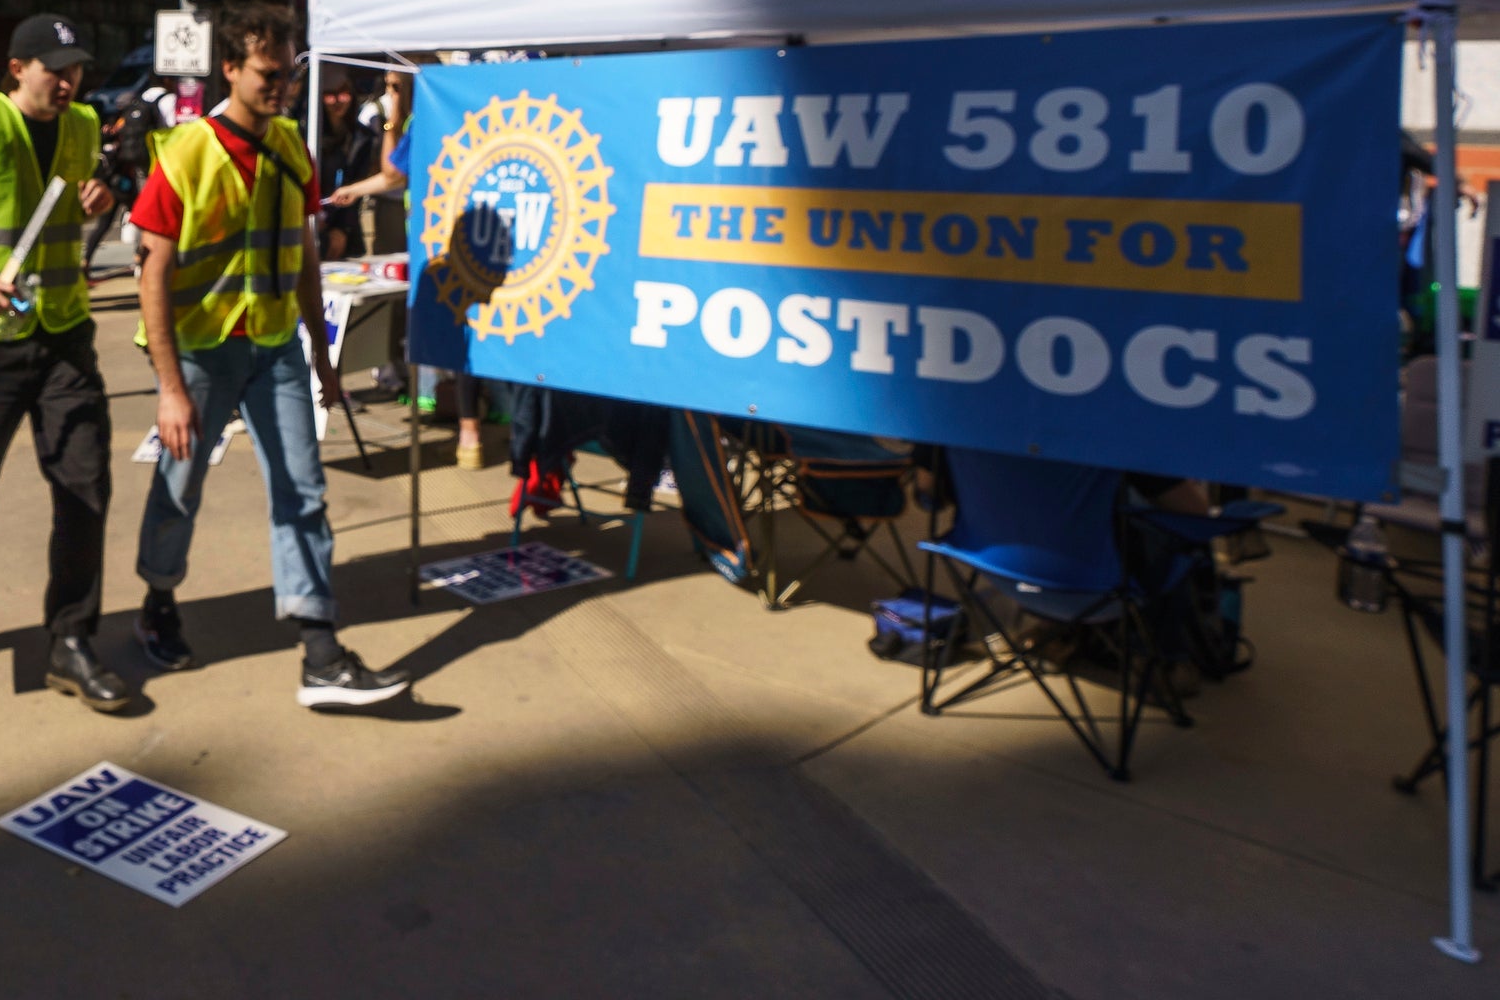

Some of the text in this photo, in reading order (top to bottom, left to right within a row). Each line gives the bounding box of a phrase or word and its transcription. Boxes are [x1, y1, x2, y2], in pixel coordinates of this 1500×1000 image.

[656, 83, 1305, 176] UAW 5810
[472, 190, 551, 263] UAW
[672, 204, 1249, 273] THE UNION FOR
[630, 280, 1317, 421] POSTDOCS
[11, 769, 121, 828] UAW
[73, 792, 185, 858] STRIKE
[75, 798, 130, 829] ON
[121, 814, 209, 866] UNFAIR
[149, 826, 228, 873] LABOR
[157, 827, 269, 895] PRACTICE
